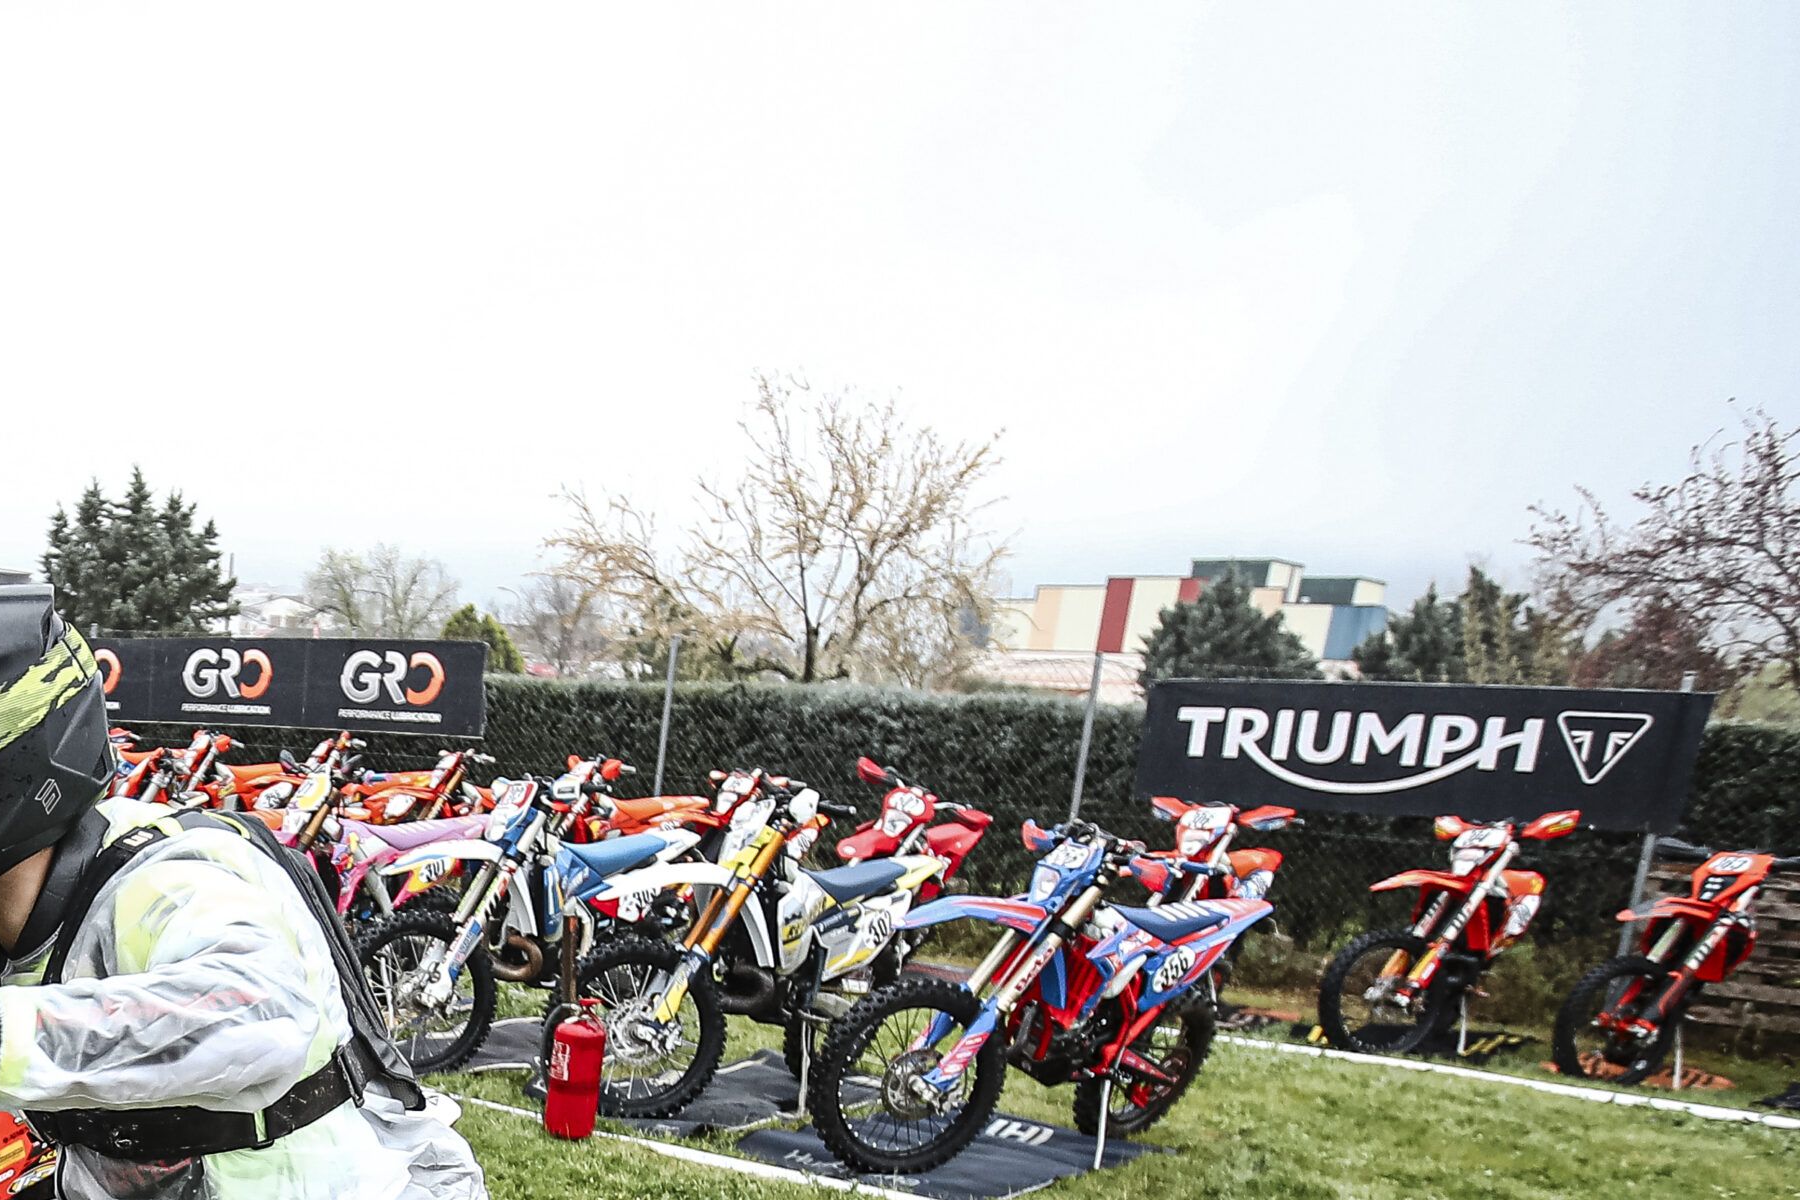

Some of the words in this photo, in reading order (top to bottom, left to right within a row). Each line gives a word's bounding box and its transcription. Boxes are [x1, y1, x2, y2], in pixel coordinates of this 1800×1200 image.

[182, 648, 273, 699] GRO
[340, 649, 446, 706] GRO
[1177, 706, 1545, 794] TRIUMPH
